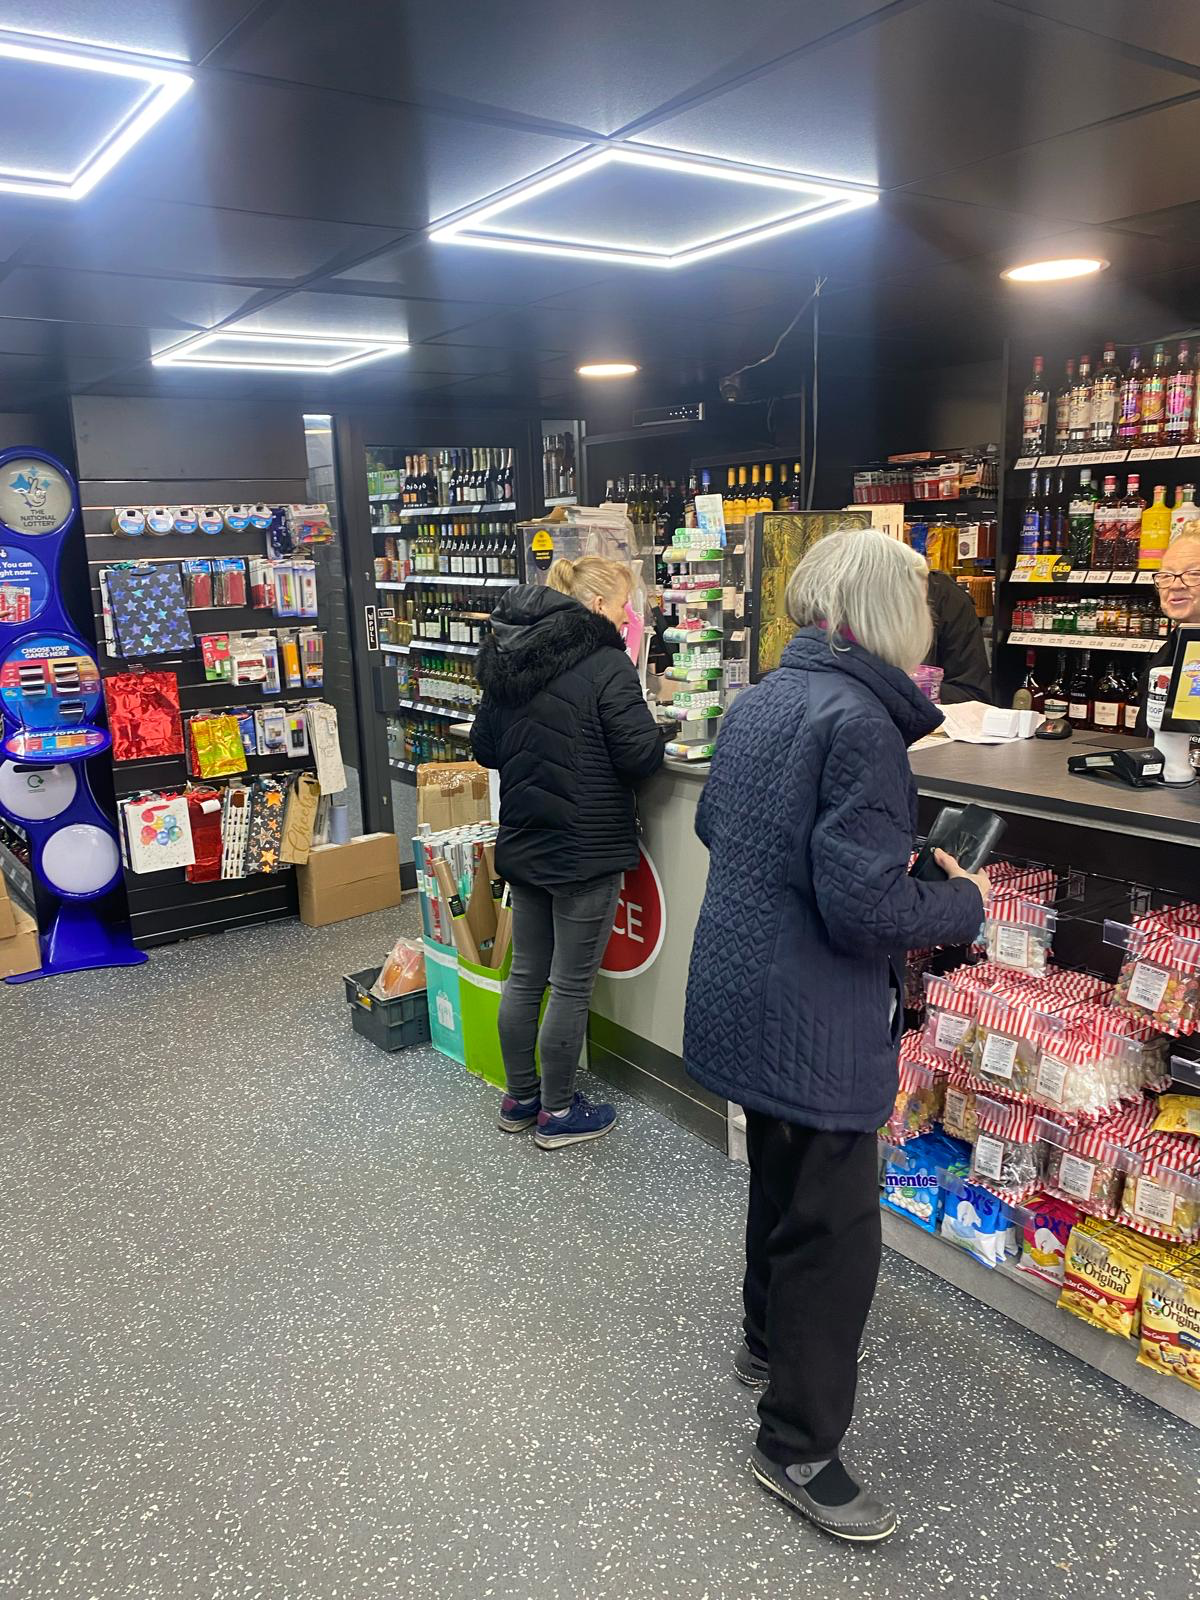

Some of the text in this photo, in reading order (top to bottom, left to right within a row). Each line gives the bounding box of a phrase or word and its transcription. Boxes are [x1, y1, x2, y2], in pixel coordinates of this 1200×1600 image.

[885, 1172, 938, 1188] mentos
[1083, 1259, 1127, 1295] Original
[1077, 1282, 1100, 1300] Candies
[1161, 1303, 1200, 1333] Origina
